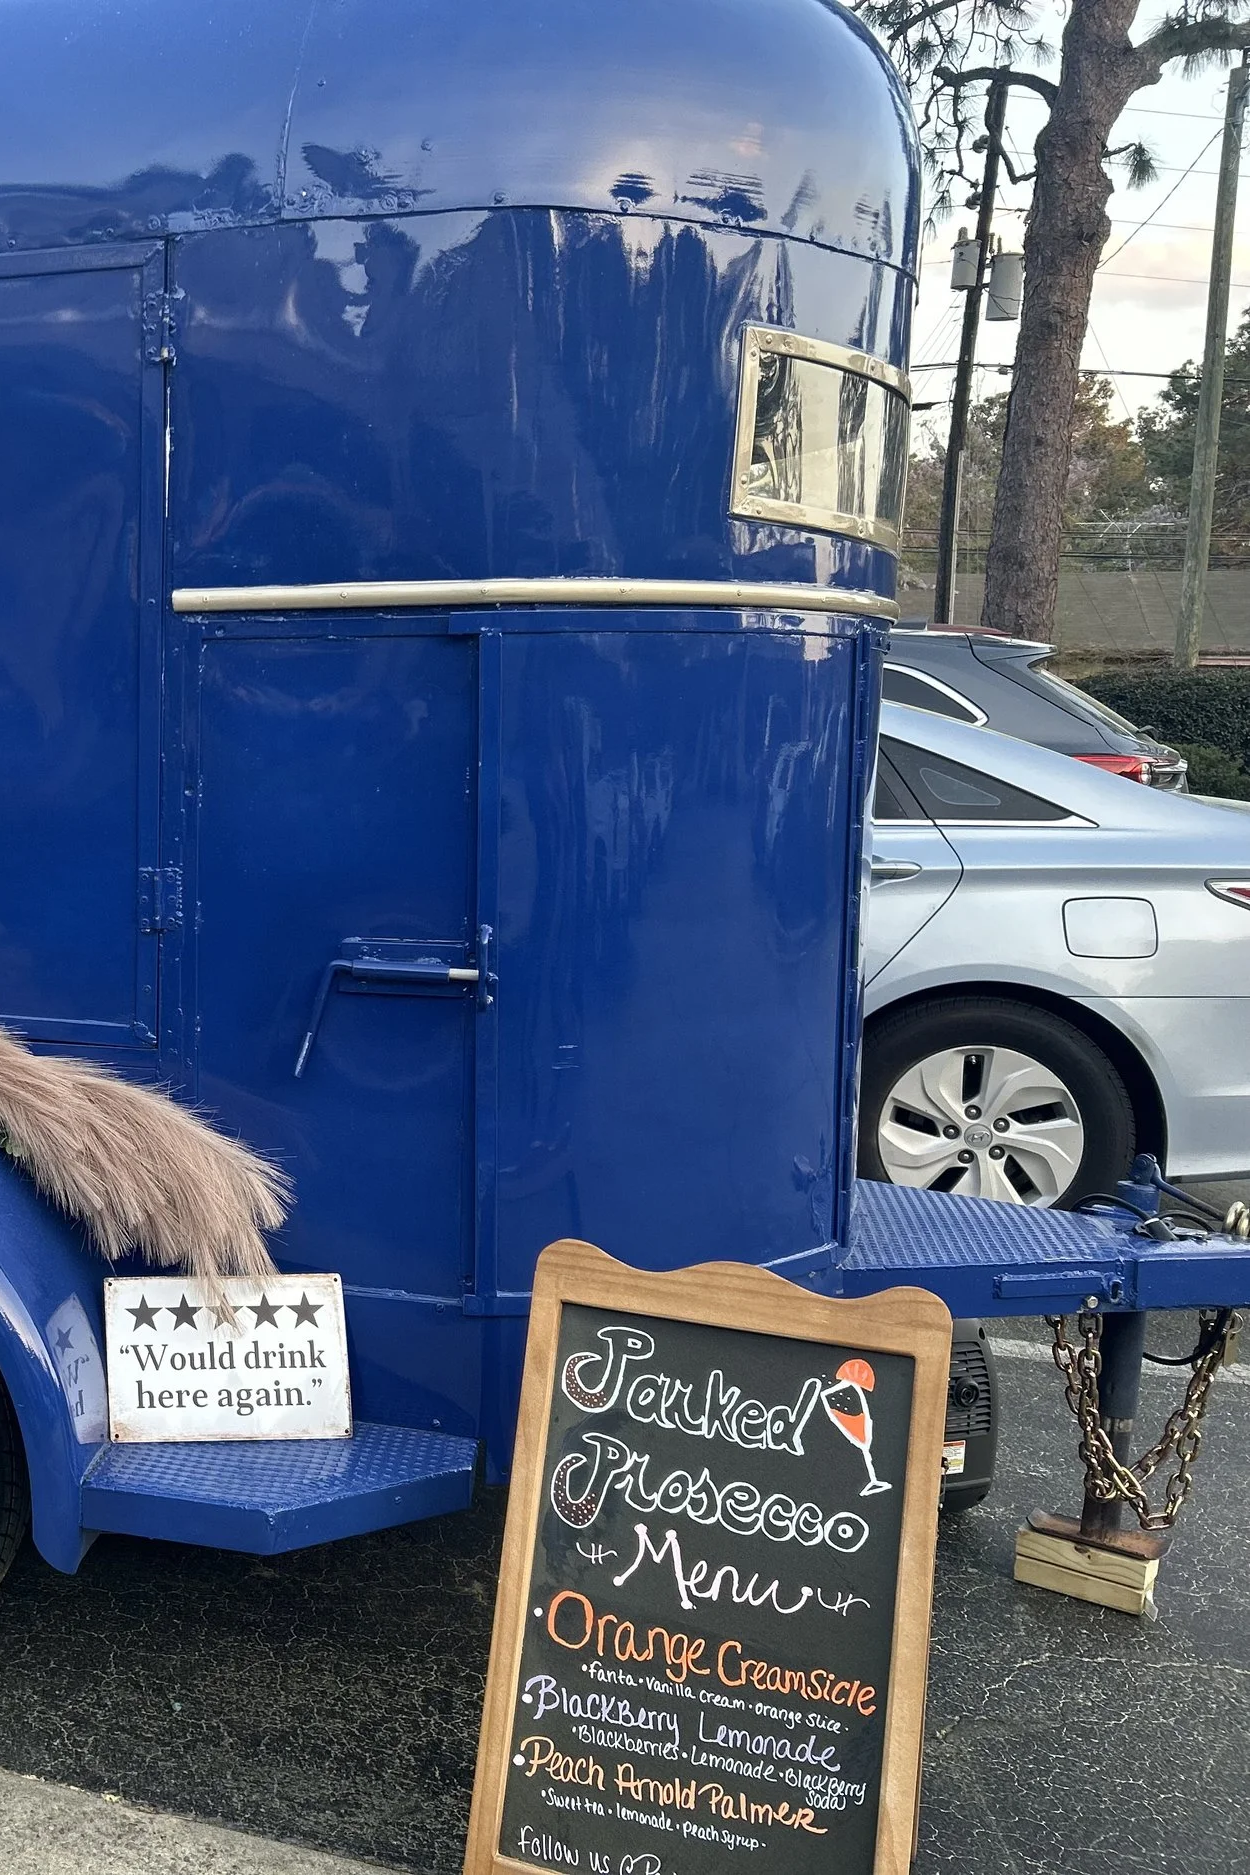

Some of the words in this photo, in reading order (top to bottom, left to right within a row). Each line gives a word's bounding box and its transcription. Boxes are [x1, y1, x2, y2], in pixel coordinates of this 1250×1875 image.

[119, 1341, 236, 1372] “Would
[244, 1339, 327, 1370] drink
[136, 1380, 208, 1409] here
[217, 1378, 323, 1416] again.”
[562, 1326, 822, 1456] Parked
[551, 1433, 869, 1553] Prosecco
[612, 1523, 814, 1614] Menu
[547, 1590, 711, 1683] Orange
[698, 1711, 841, 1772] Lemonade
[699, 1689, 745, 1710] cream
[755, 1702, 802, 1729] orange
[520, 1735, 606, 1791] Peach
[613, 1762, 697, 1811] Arnold
[690, 1744, 778, 1783] Lemonade
